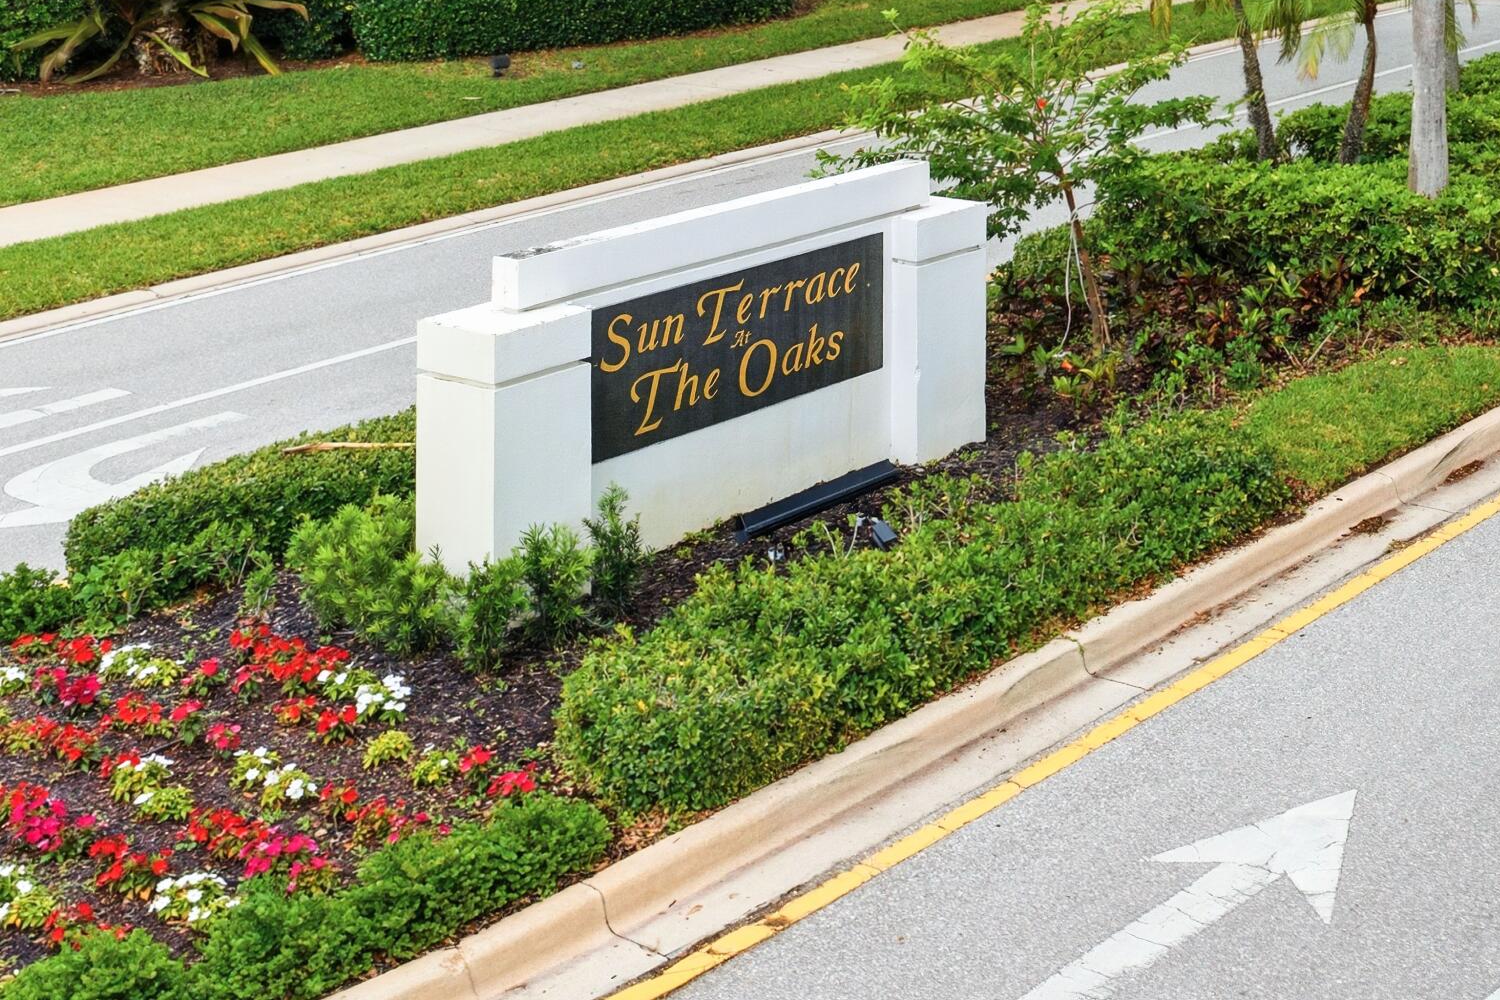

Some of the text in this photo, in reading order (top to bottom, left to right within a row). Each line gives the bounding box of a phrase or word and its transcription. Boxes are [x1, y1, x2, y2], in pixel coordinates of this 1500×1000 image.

[600, 262, 860, 372] Sun Terrace
[730, 329, 753, 349] At
[631, 323, 845, 436] The Oaks
